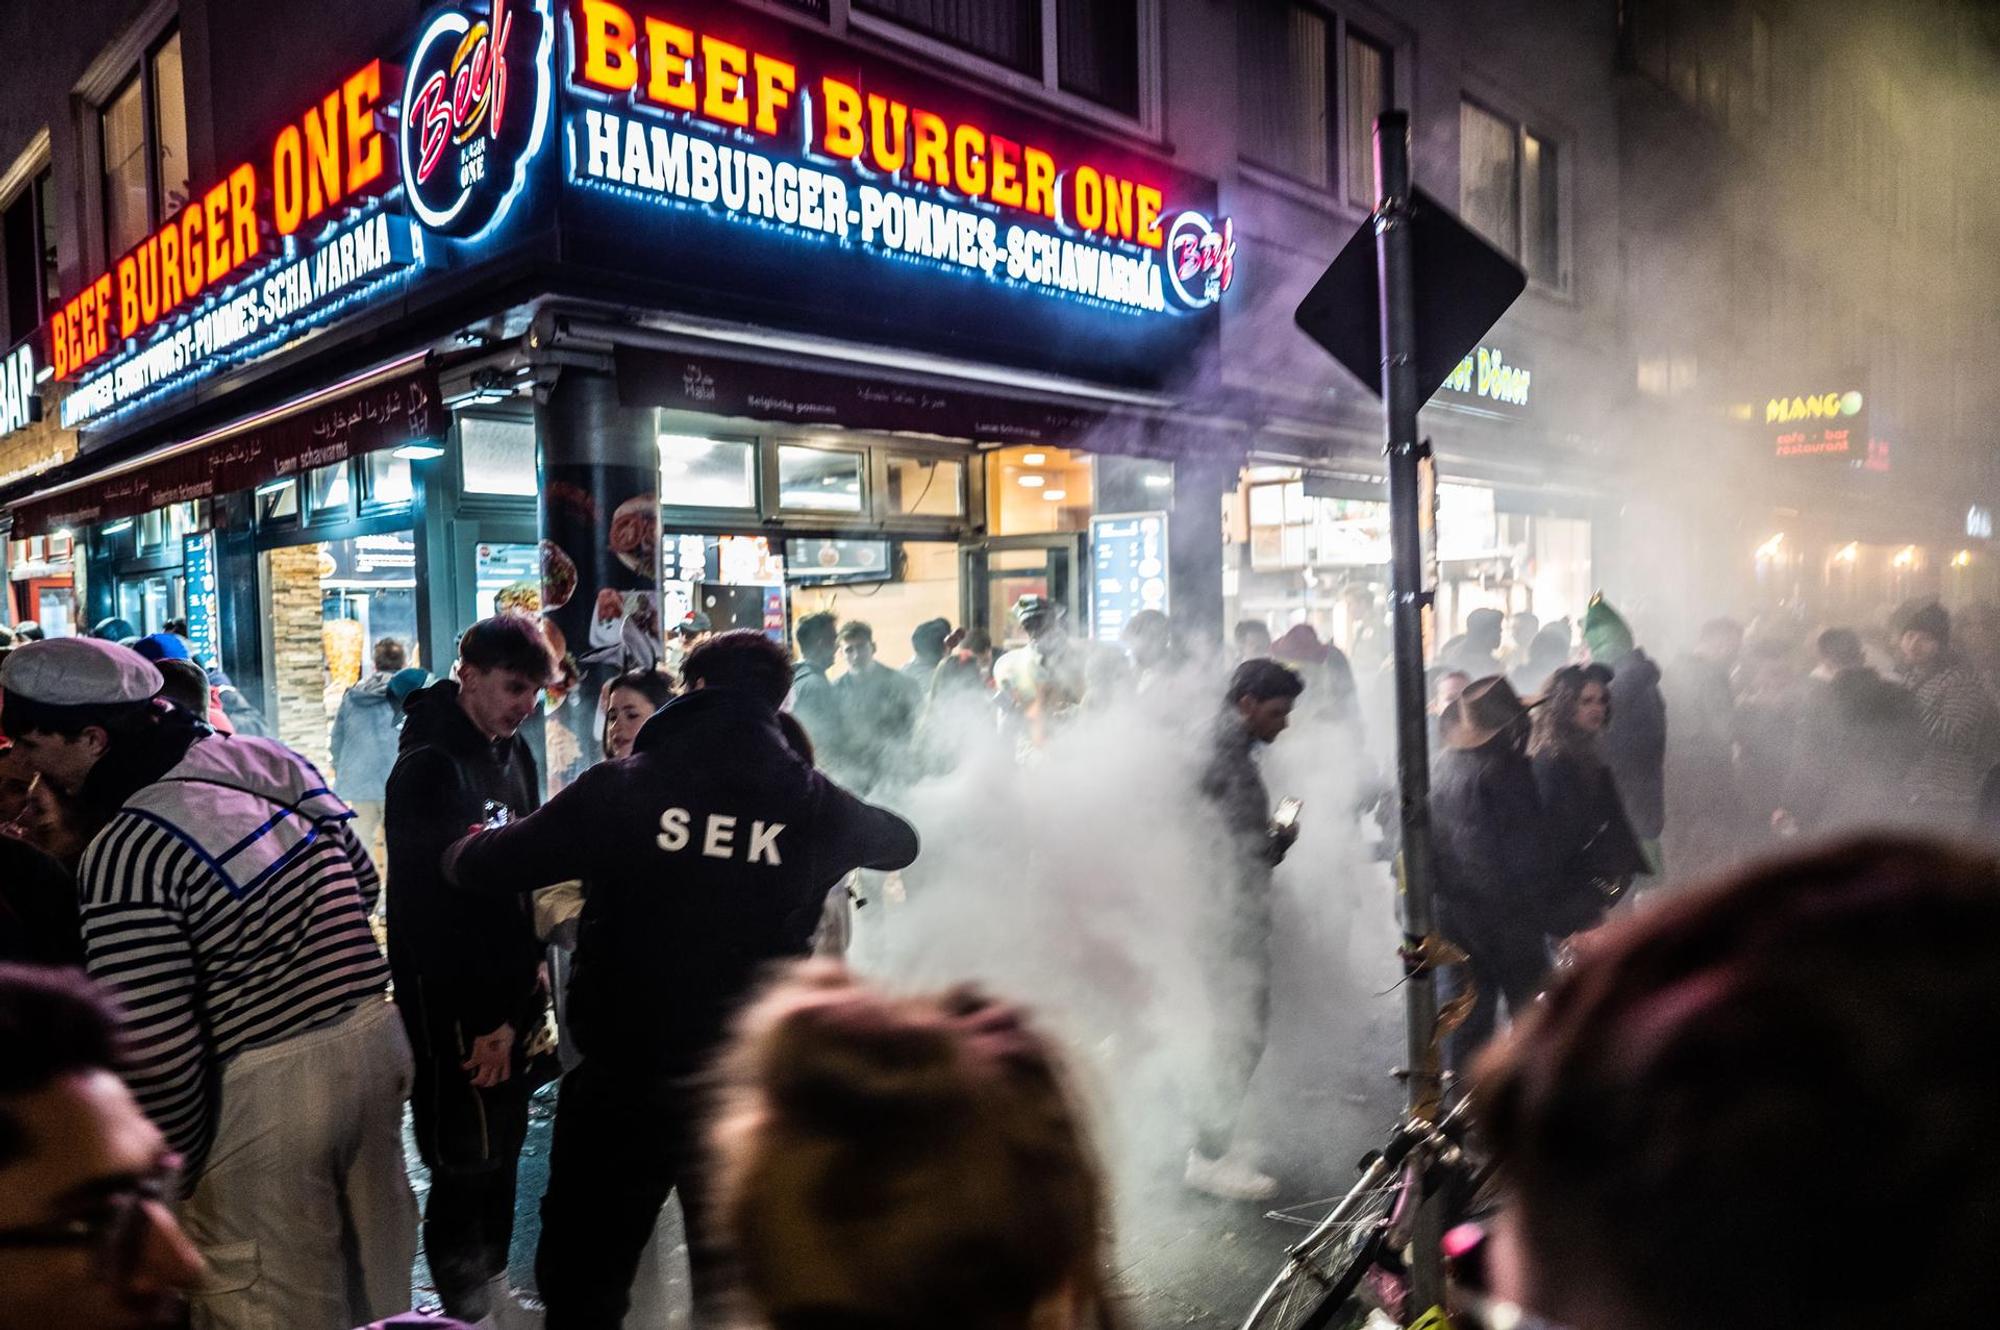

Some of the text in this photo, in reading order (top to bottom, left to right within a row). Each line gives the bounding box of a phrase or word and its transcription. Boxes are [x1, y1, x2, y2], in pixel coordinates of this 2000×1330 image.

[409, 0, 512, 184] Beef
[582, 0, 1164, 250] BEEF BURGER ONE
[52, 57, 384, 382] BEEF BURGER ONE
[656, 806, 787, 867] SEK
